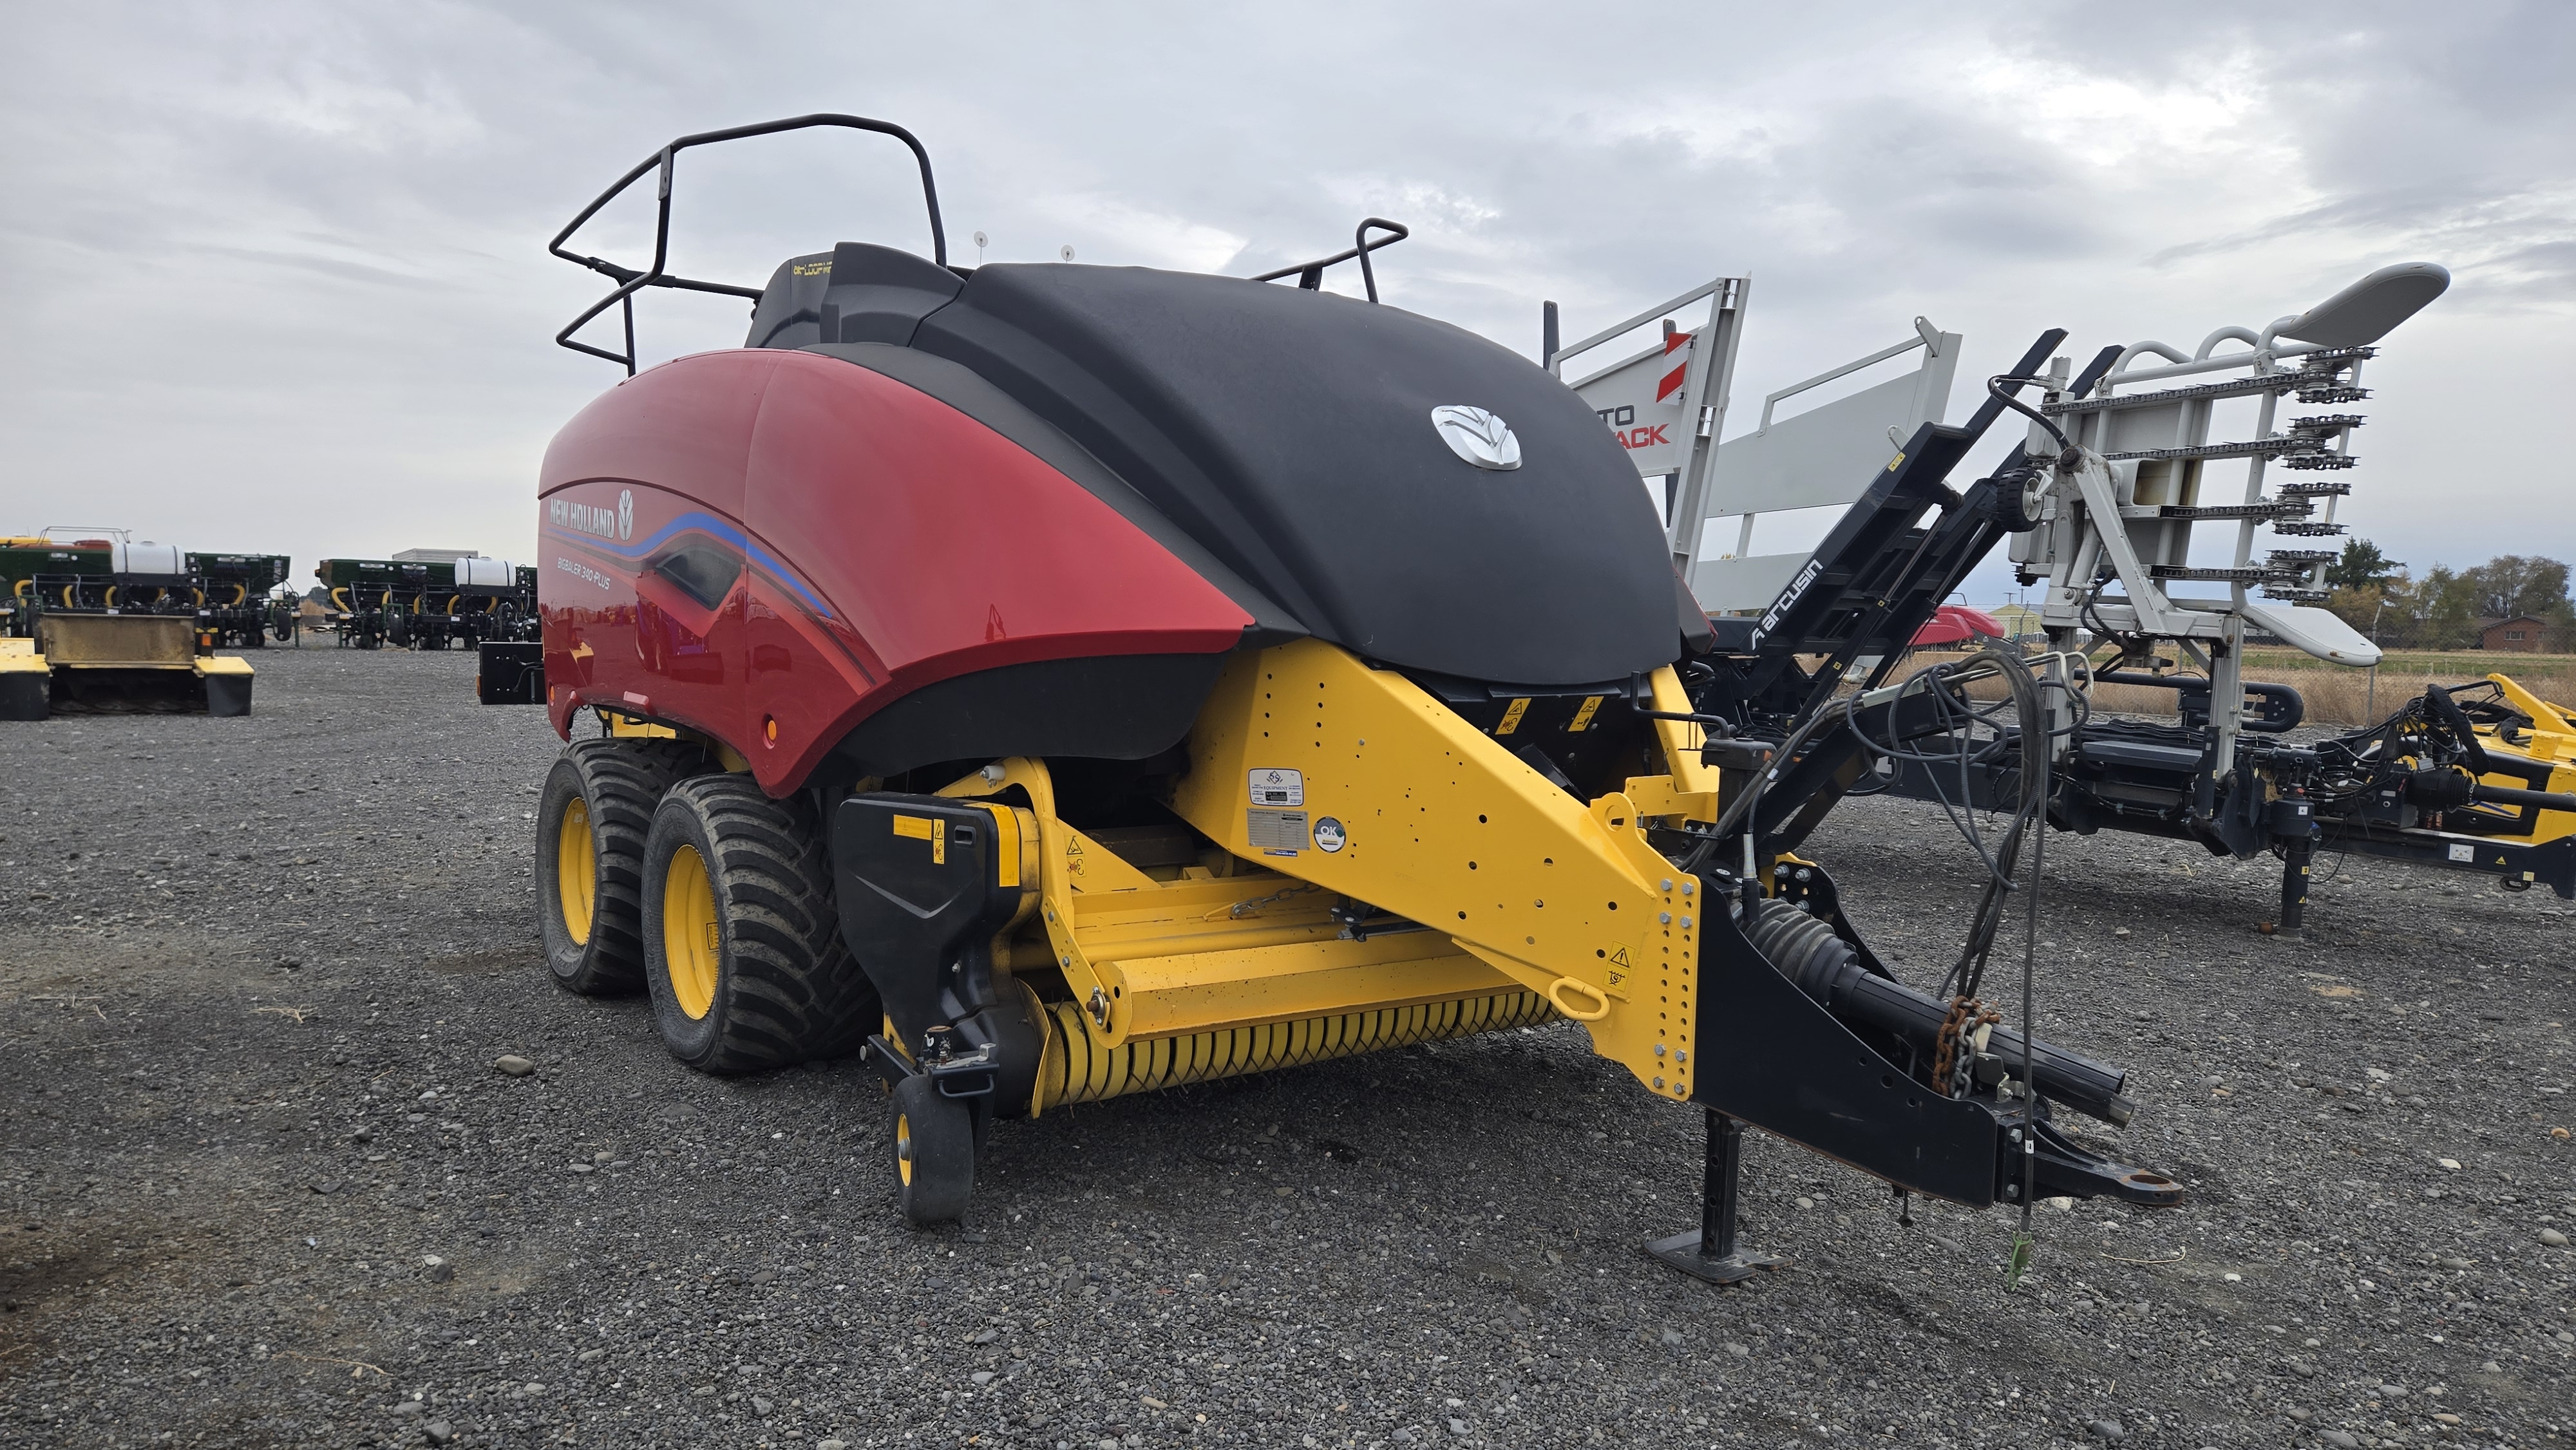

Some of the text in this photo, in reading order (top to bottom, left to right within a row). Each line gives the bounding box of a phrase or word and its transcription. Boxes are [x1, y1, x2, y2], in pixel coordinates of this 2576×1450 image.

[1613, 423, 1671, 449] ACK
[550, 498, 614, 538] NEW HOLLAND
[558, 557, 582, 576] BIGBALER
[582, 566, 593, 581] 340
[1762, 559, 1824, 632] arcusin
[1320, 825, 1338, 836] OK
